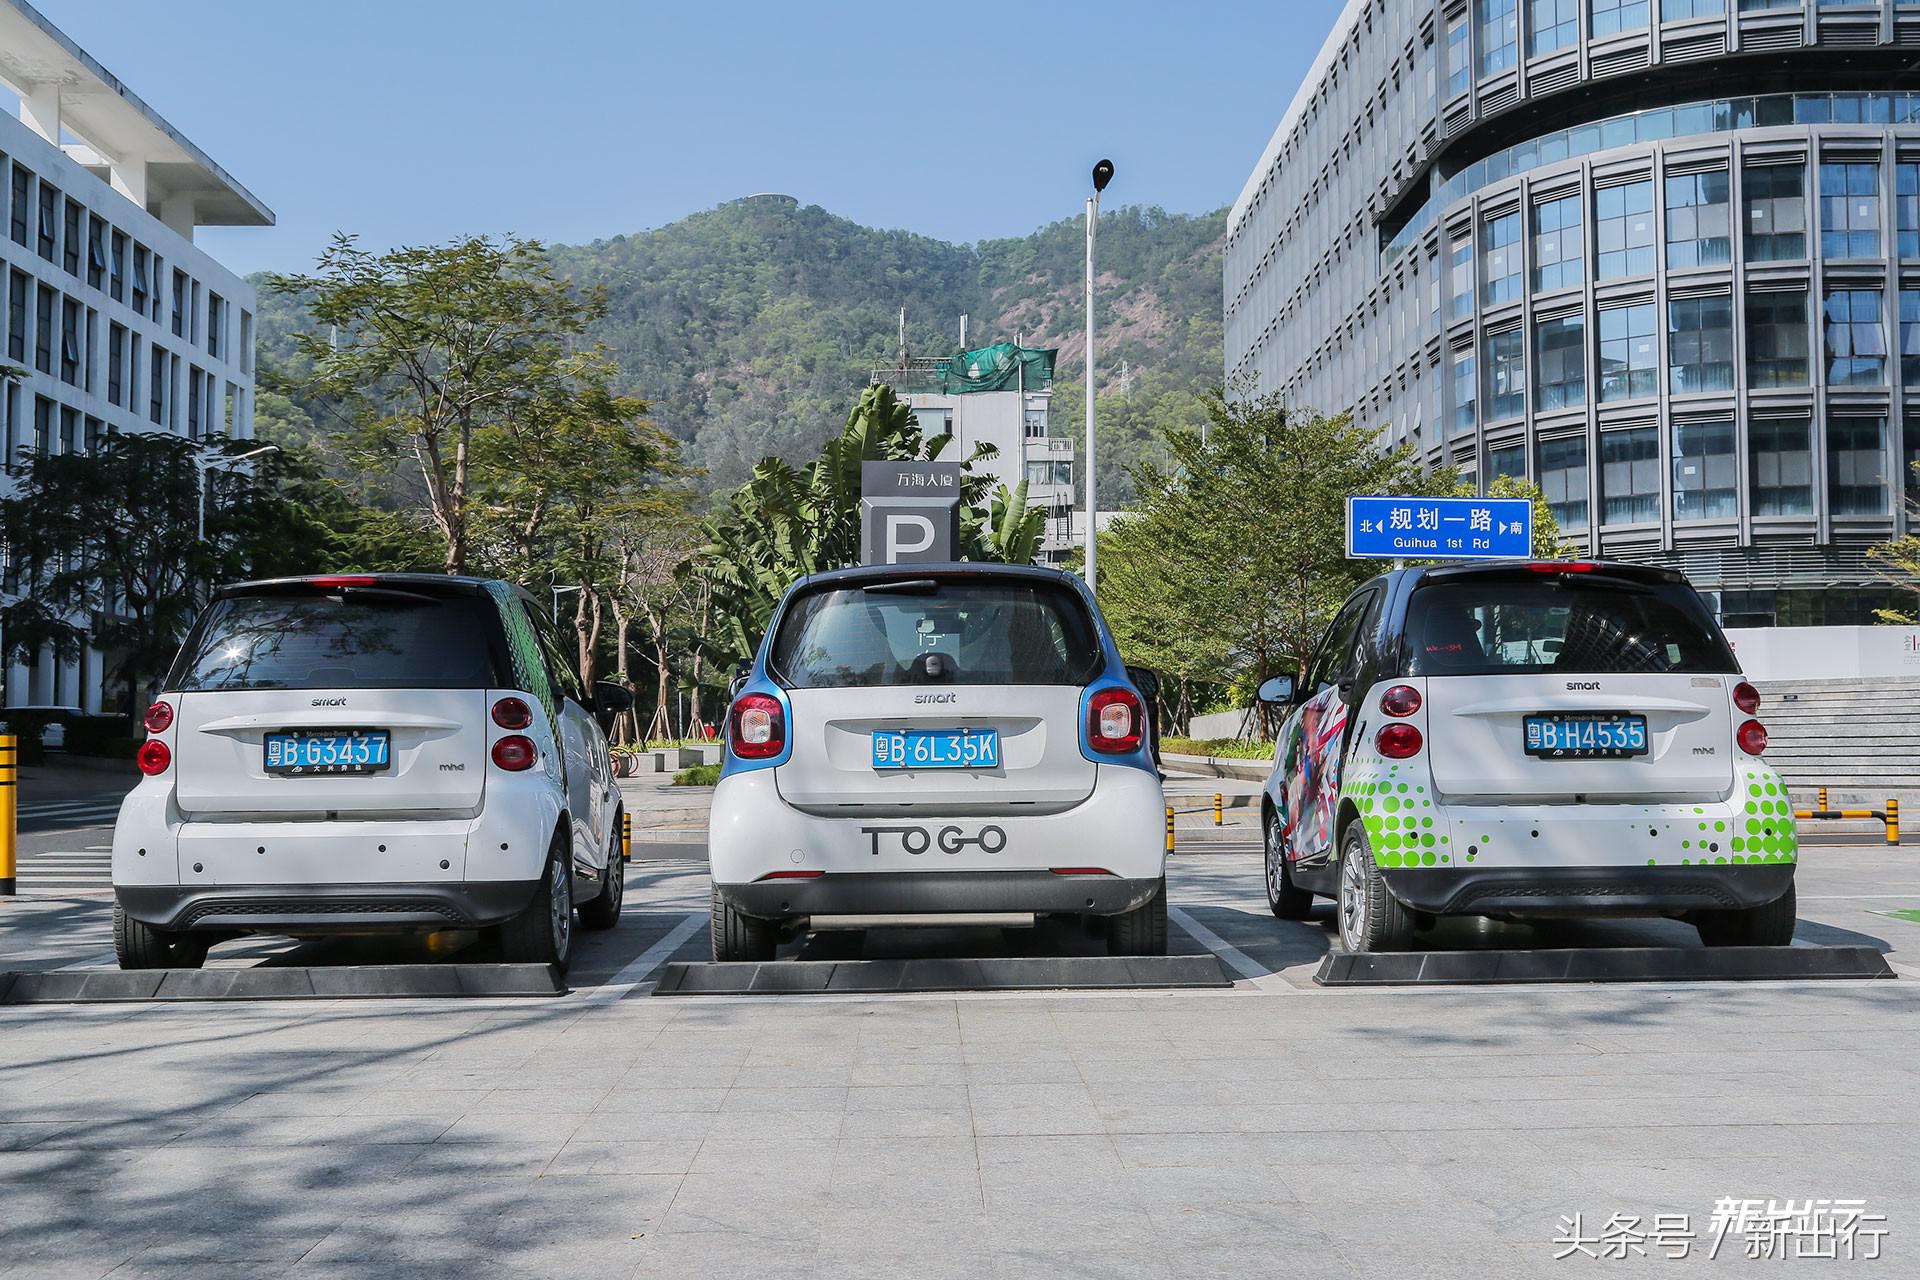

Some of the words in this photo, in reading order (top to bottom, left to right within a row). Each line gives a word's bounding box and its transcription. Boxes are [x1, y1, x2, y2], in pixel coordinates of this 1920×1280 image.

[1360, 519, 1373, 534] 北
[1389, 507, 1493, 532] 规划一路
[1510, 520, 1523, 535] 南
[886, 514, 936, 565] P
[1393, 537, 1438, 549] Guihua
[1446, 538, 1463, 549] 1st
[1472, 538, 1490, 550] Rd
[1565, 680, 1601, 691] smart
[311, 695, 348, 707] smart
[914, 691, 957, 705] smart
[439, 762, 465, 772] mhd
[861, 824, 1007, 855] TOGO
